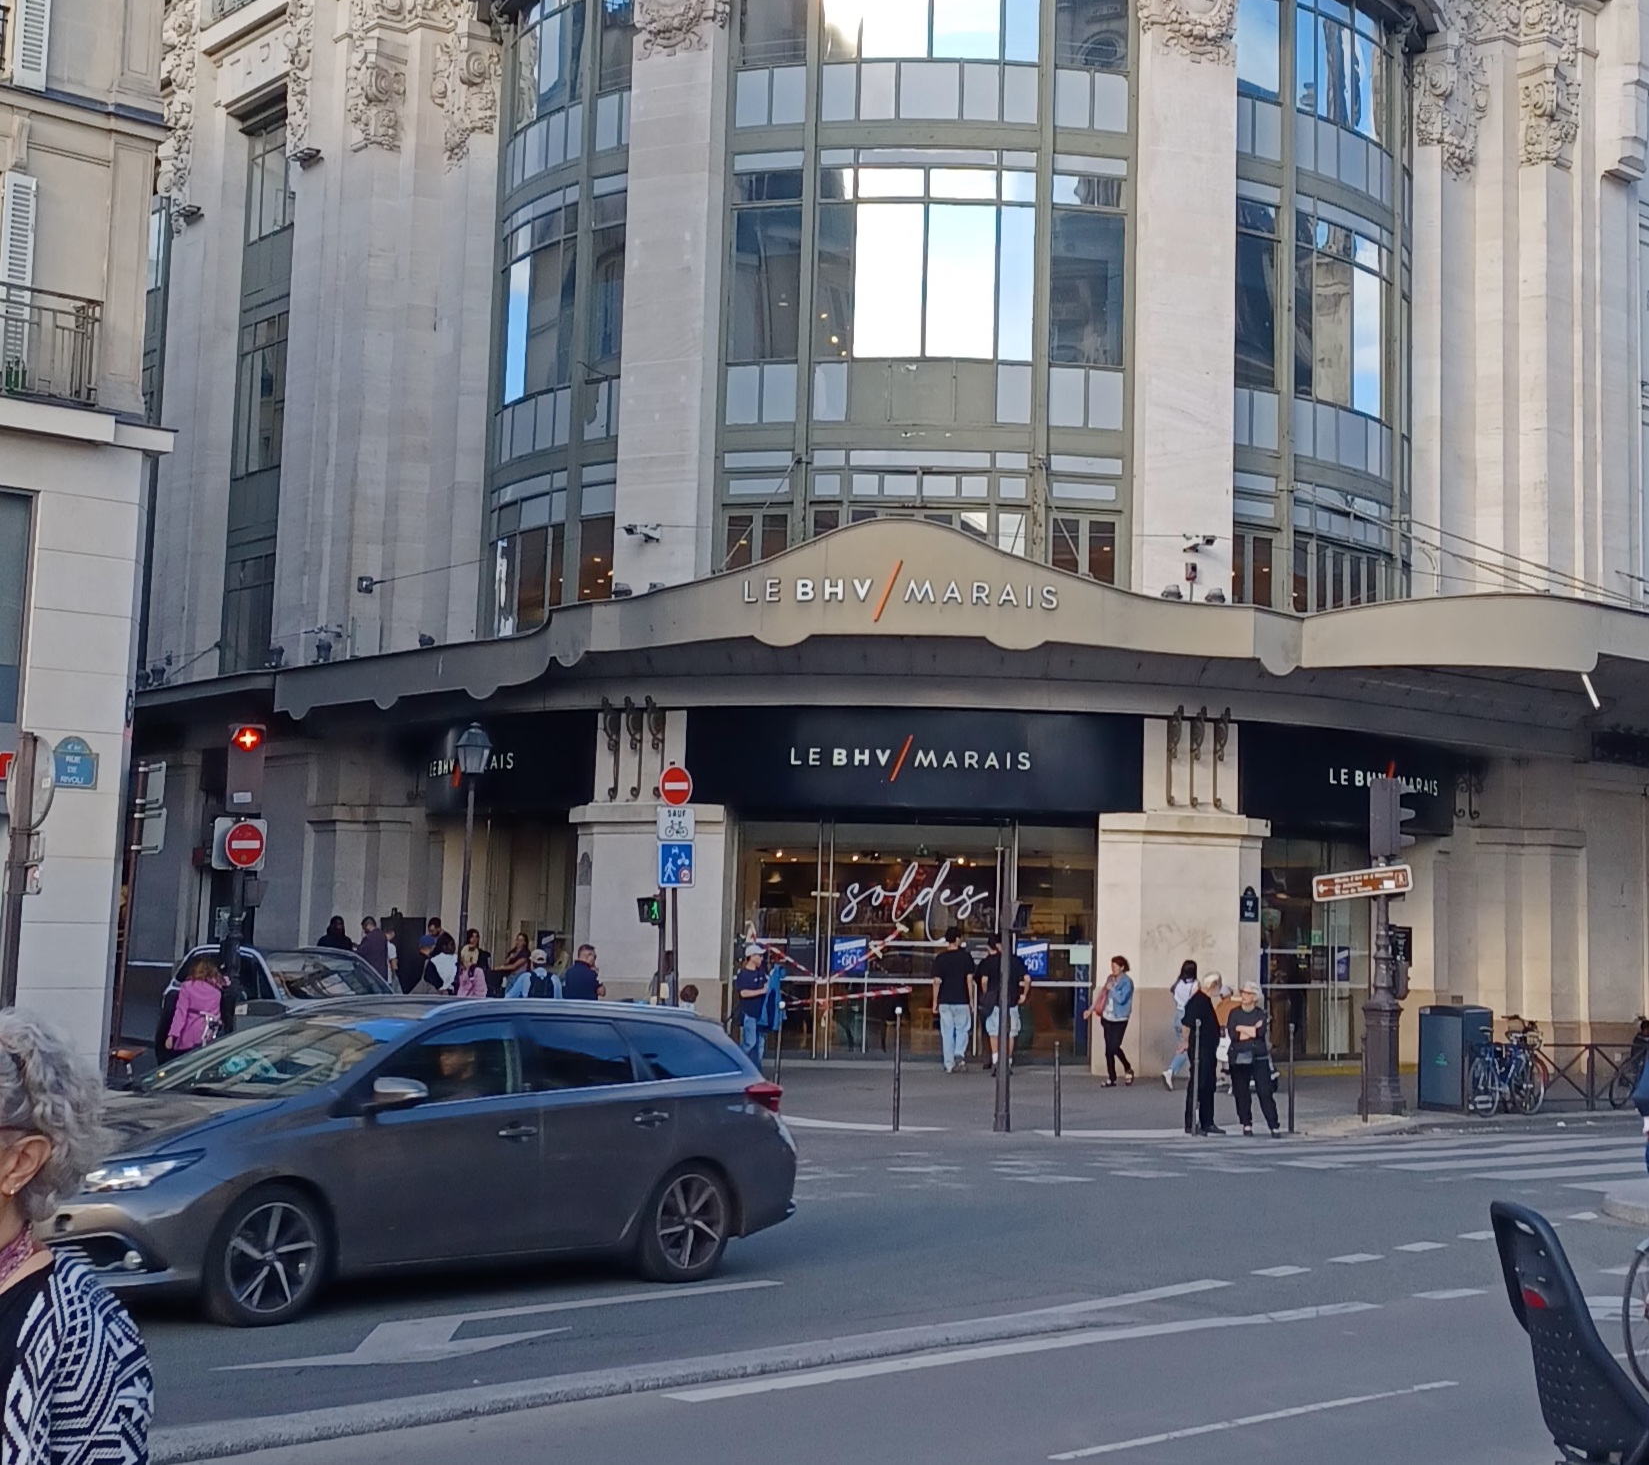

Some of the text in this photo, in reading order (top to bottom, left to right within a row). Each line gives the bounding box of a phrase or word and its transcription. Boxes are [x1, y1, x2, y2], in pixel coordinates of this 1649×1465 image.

[743, 578, 782, 603] LE
[796, 577, 873, 603] BHV
[903, 579, 1060, 611] MARAIS
[65, 755, 81, 764] RUE
[790, 746, 821, 766] LE
[832, 748, 892, 767] BHV
[914, 749, 1031, 771] MARAIS
[60, 775, 84, 784] RIVOLI
[1329, 767, 1349, 785] LE
[667, 809, 686, 817] SAUF
[840, 860, 988, 944] soldes
